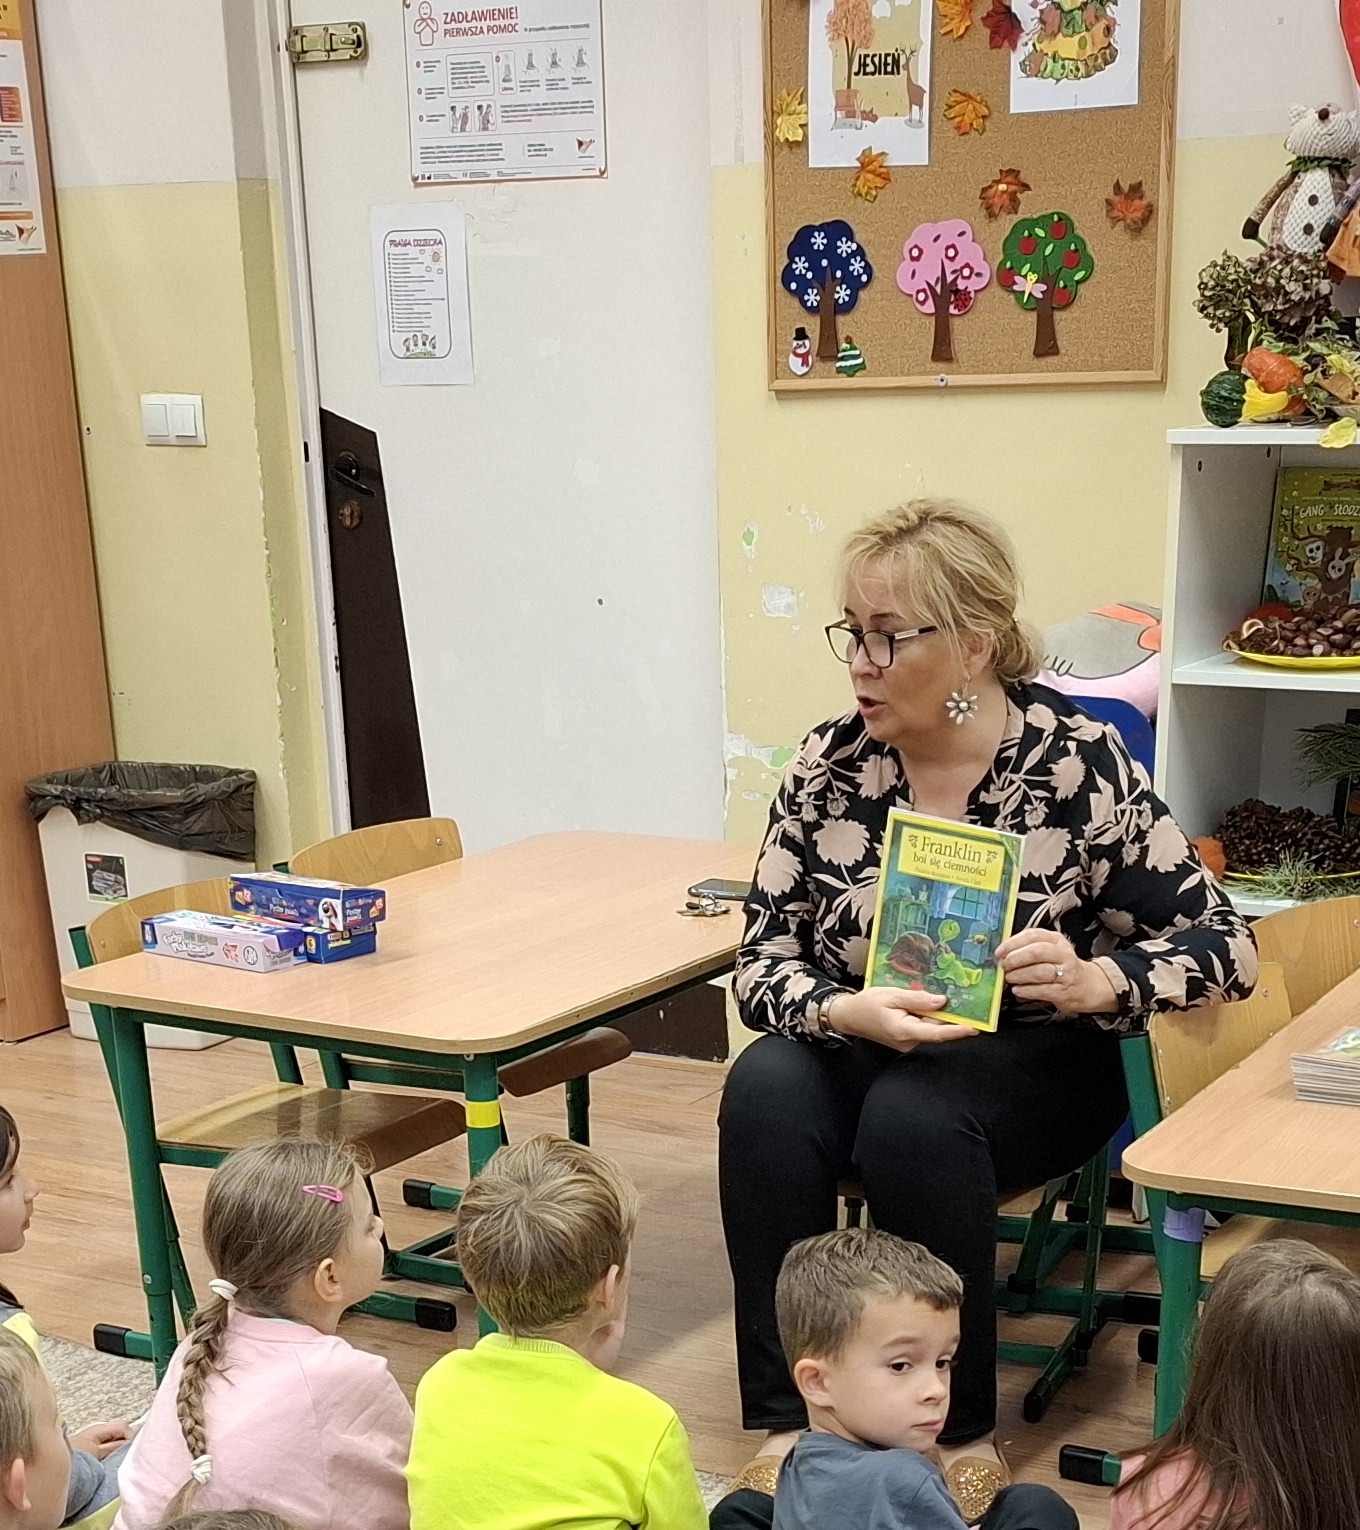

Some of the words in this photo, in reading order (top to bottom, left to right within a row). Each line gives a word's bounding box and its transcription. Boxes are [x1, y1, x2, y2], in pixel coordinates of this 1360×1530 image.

[443, 6, 519, 25] ZADŁAWIENIE!
[443, 25, 485, 39] PIERWSZA
[486, 23, 519, 35] POMOC
[853, 47, 900, 77] JESIEŃ
[1300, 504, 1325, 518] GANG
[920, 835, 982, 863] Franklin
[913, 851, 928, 864] boi
[929, 857, 941, 869] się
[943, 860, 987, 877] ciemności
